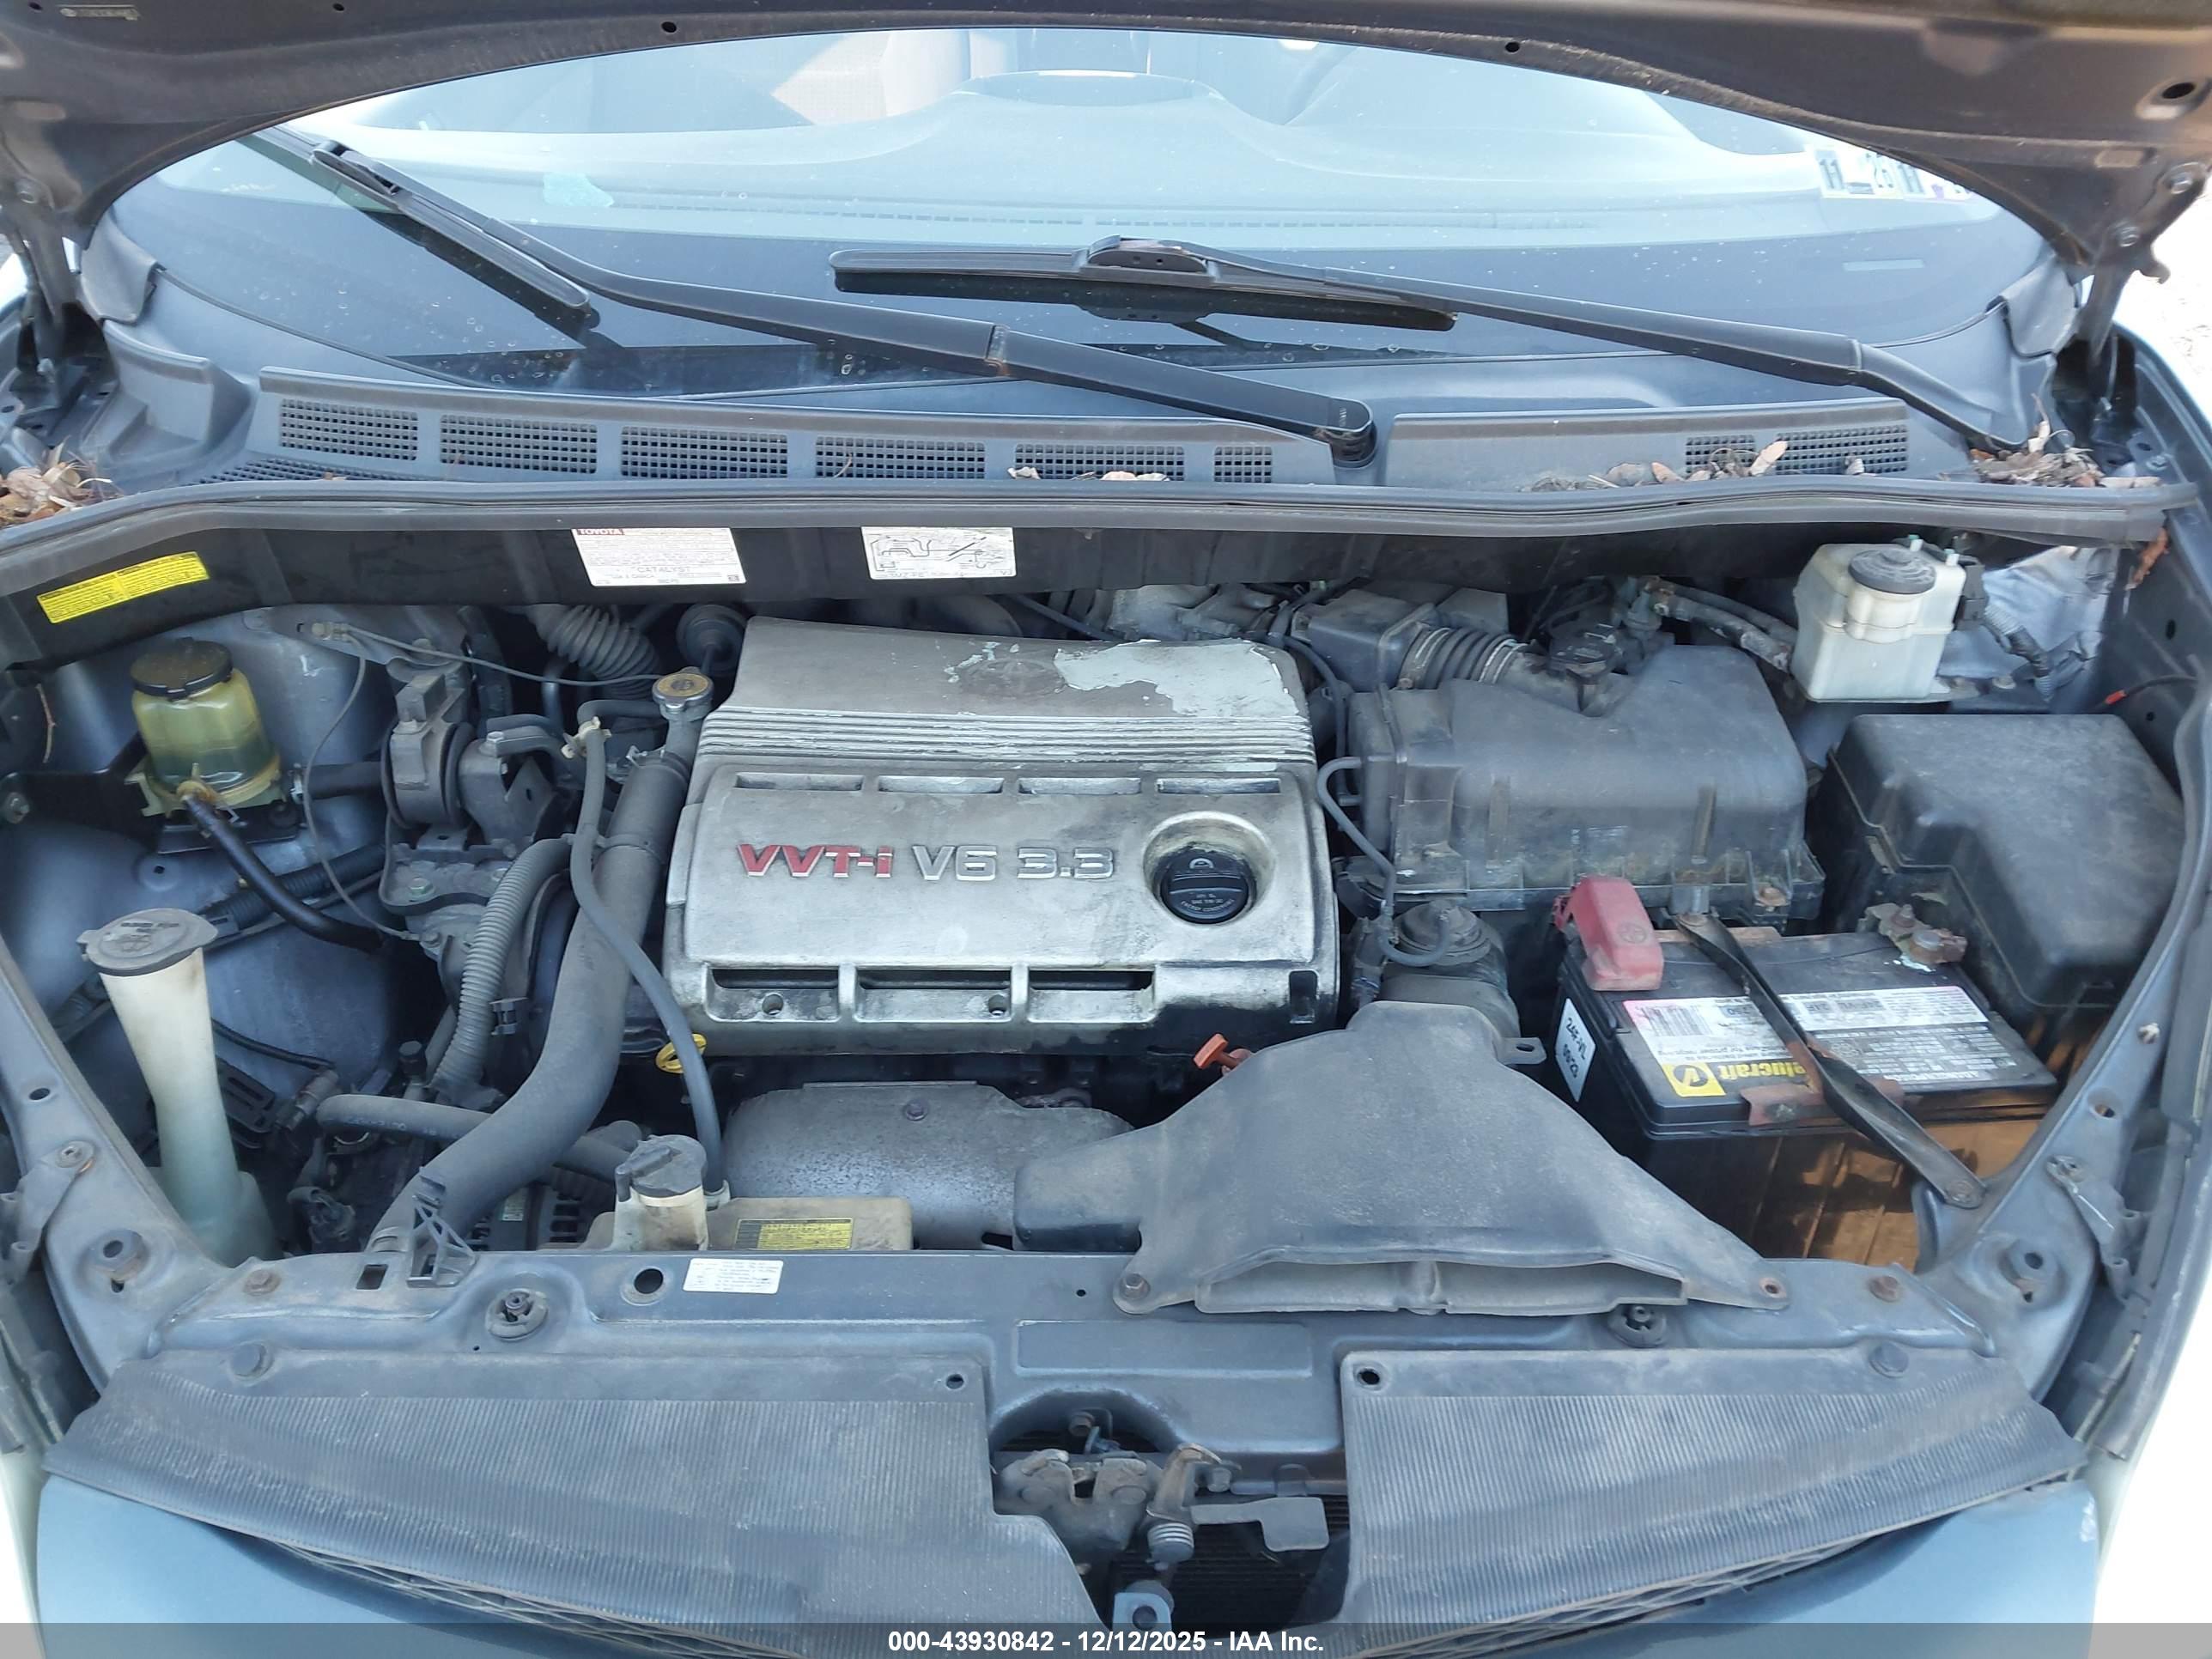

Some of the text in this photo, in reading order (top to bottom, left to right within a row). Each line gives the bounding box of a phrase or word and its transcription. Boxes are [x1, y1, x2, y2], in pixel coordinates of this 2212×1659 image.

[737, 843, 1115, 881] VVT-i V6 3.3
